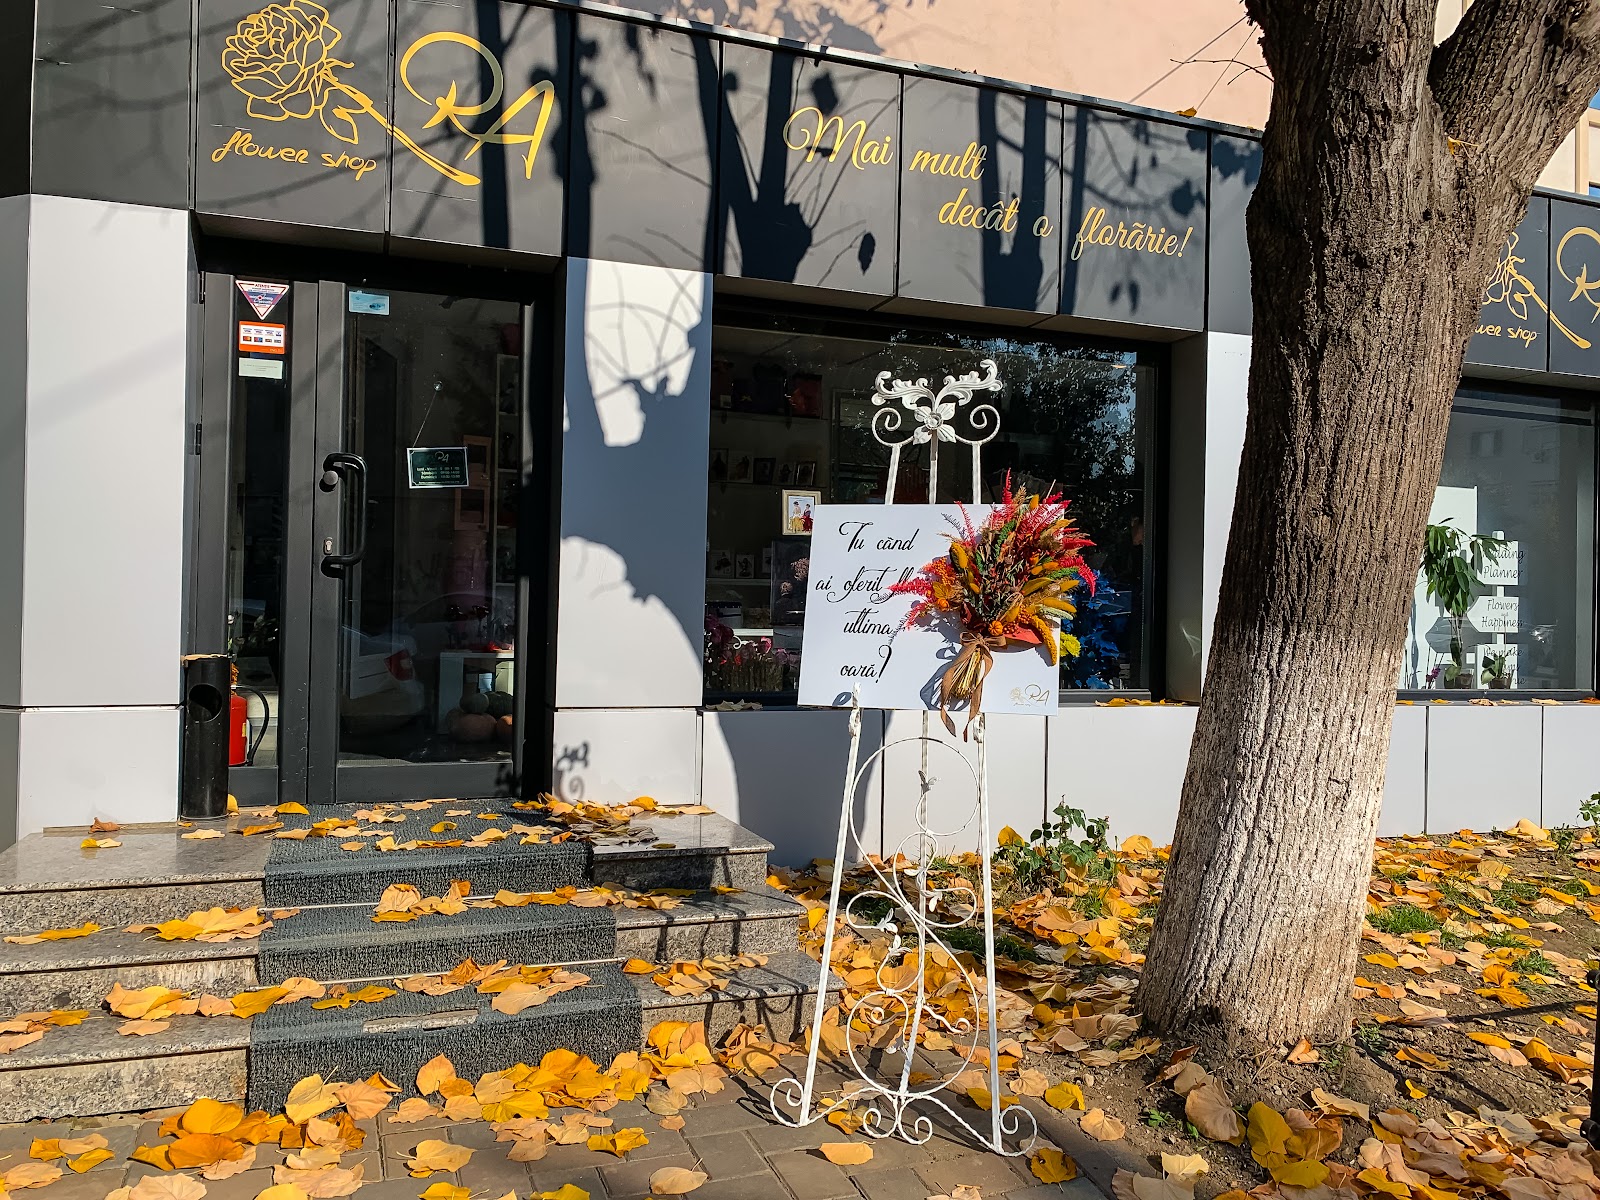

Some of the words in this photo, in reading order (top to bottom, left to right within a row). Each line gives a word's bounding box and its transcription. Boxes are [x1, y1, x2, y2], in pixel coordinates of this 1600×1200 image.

[783, 106, 894, 170] Mai
[909, 141, 988, 181] mult
[321, 151, 377, 181] shop
[938, 187, 1021, 233] decât
[1032, 215, 1054, 238] o
[1475, 324, 1502, 337] wer
[1507, 325, 1537, 348] shop
[838, 521, 874, 553] Tu
[815, 575, 833, 591] ai
[1484, 564, 1523, 579] Planner
[1487, 598, 1519, 612] Flowers
[843, 607, 893, 635] ultima
[1481, 616, 1524, 632] Happiness
